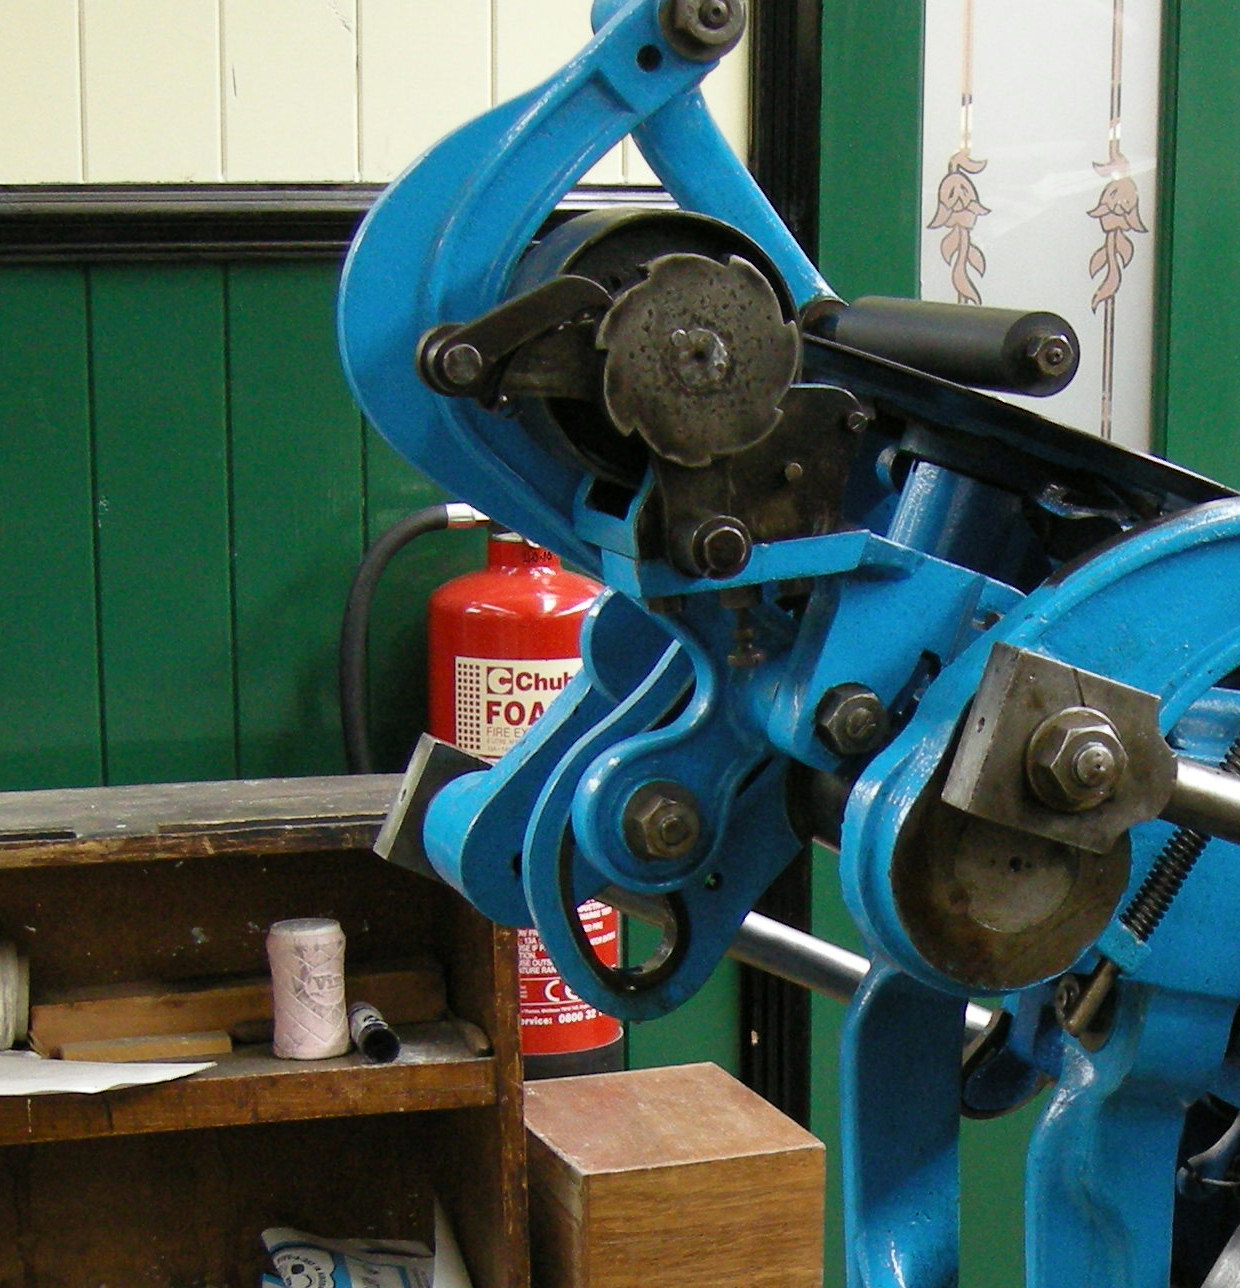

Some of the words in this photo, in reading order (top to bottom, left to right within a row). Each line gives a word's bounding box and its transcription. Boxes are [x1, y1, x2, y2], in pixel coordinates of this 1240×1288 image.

[515, 672, 572, 691] Chu
[486, 701, 544, 727] FOA
[487, 726, 511, 738] FIRE
[521, 1016, 553, 1026] ervice:
[558, 1010, 584, 1024] 0800
